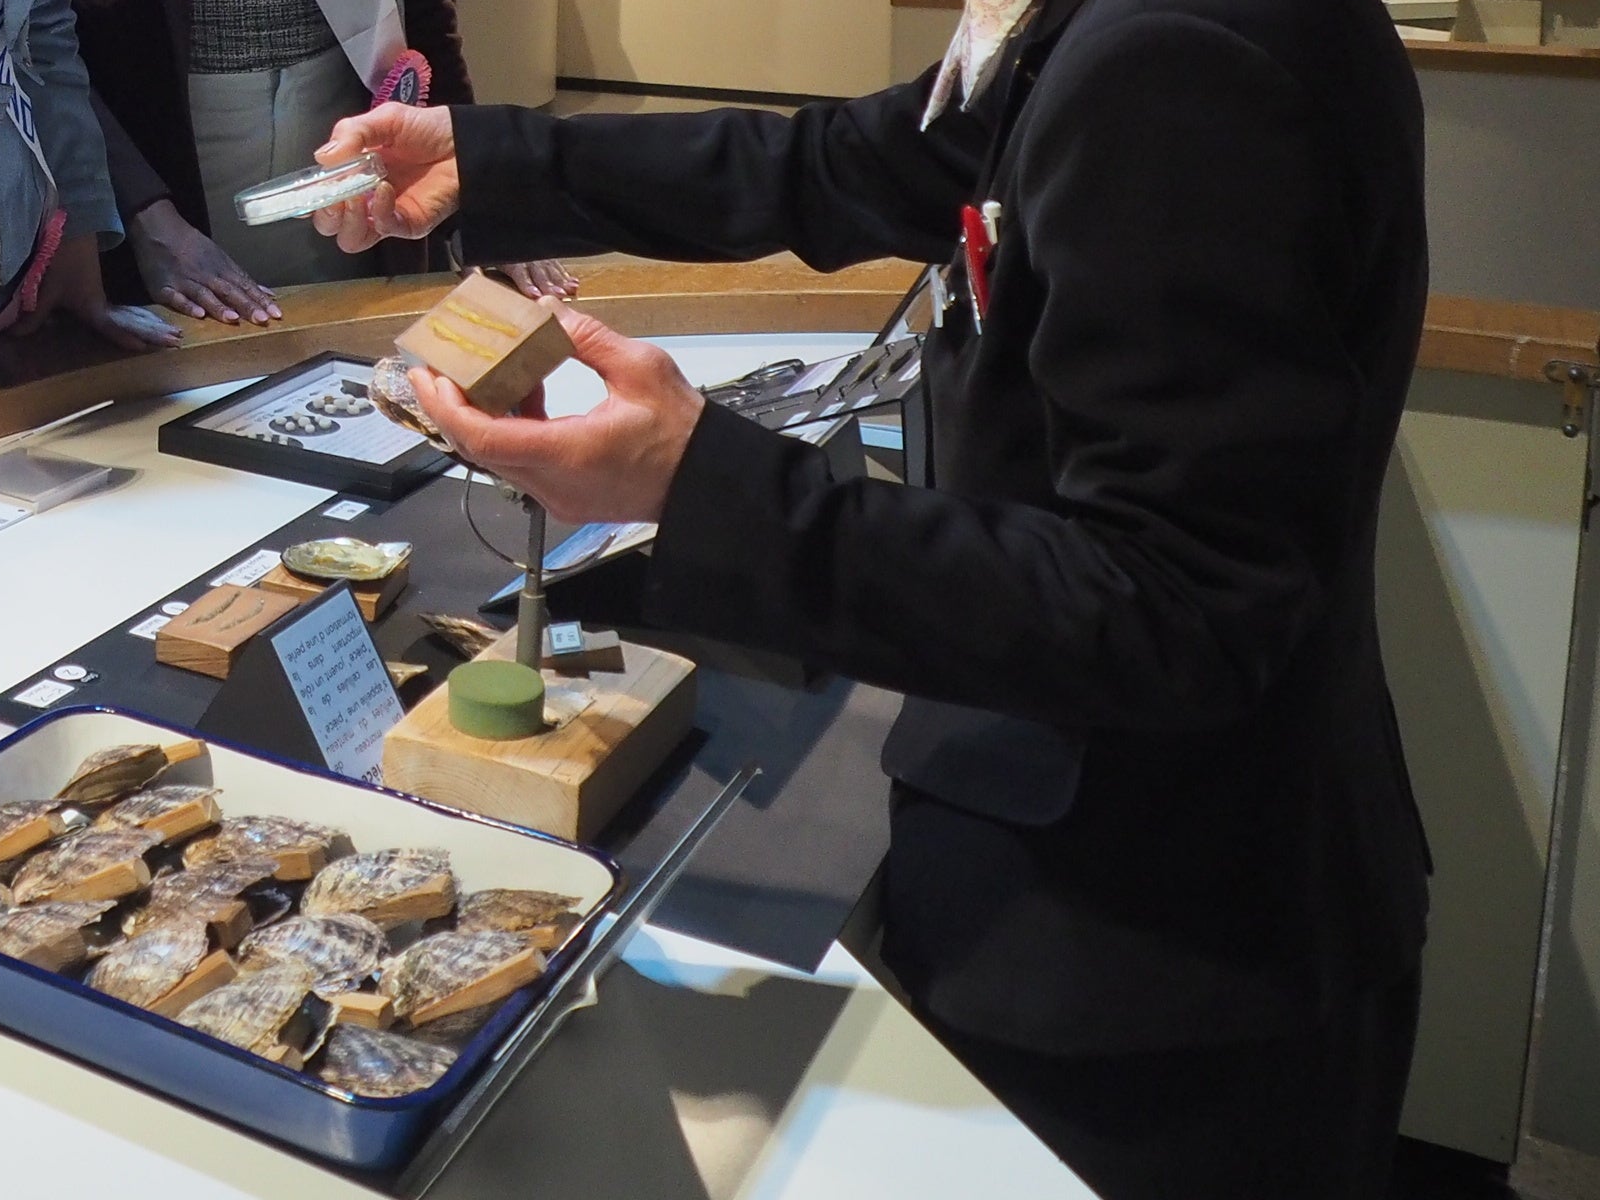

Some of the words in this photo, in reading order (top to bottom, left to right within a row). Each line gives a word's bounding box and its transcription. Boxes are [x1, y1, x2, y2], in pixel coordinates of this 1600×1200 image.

[325, 609, 358, 636] formation
[305, 631, 326, 649] d'une
[331, 625, 363, 653] important
[307, 654, 325, 670] dans
[324, 656, 345, 680] jouent
[366, 658, 379, 671] Les
[292, 671, 302, 682] la
[314, 676, 324, 688] un
[300, 683, 314, 699] rôle
[321, 693, 331, 706] de
[307, 705, 317, 716] la
[346, 701, 360, 716] une
[358, 717, 368, 731] du
[326, 730, 355, 753] manteau
